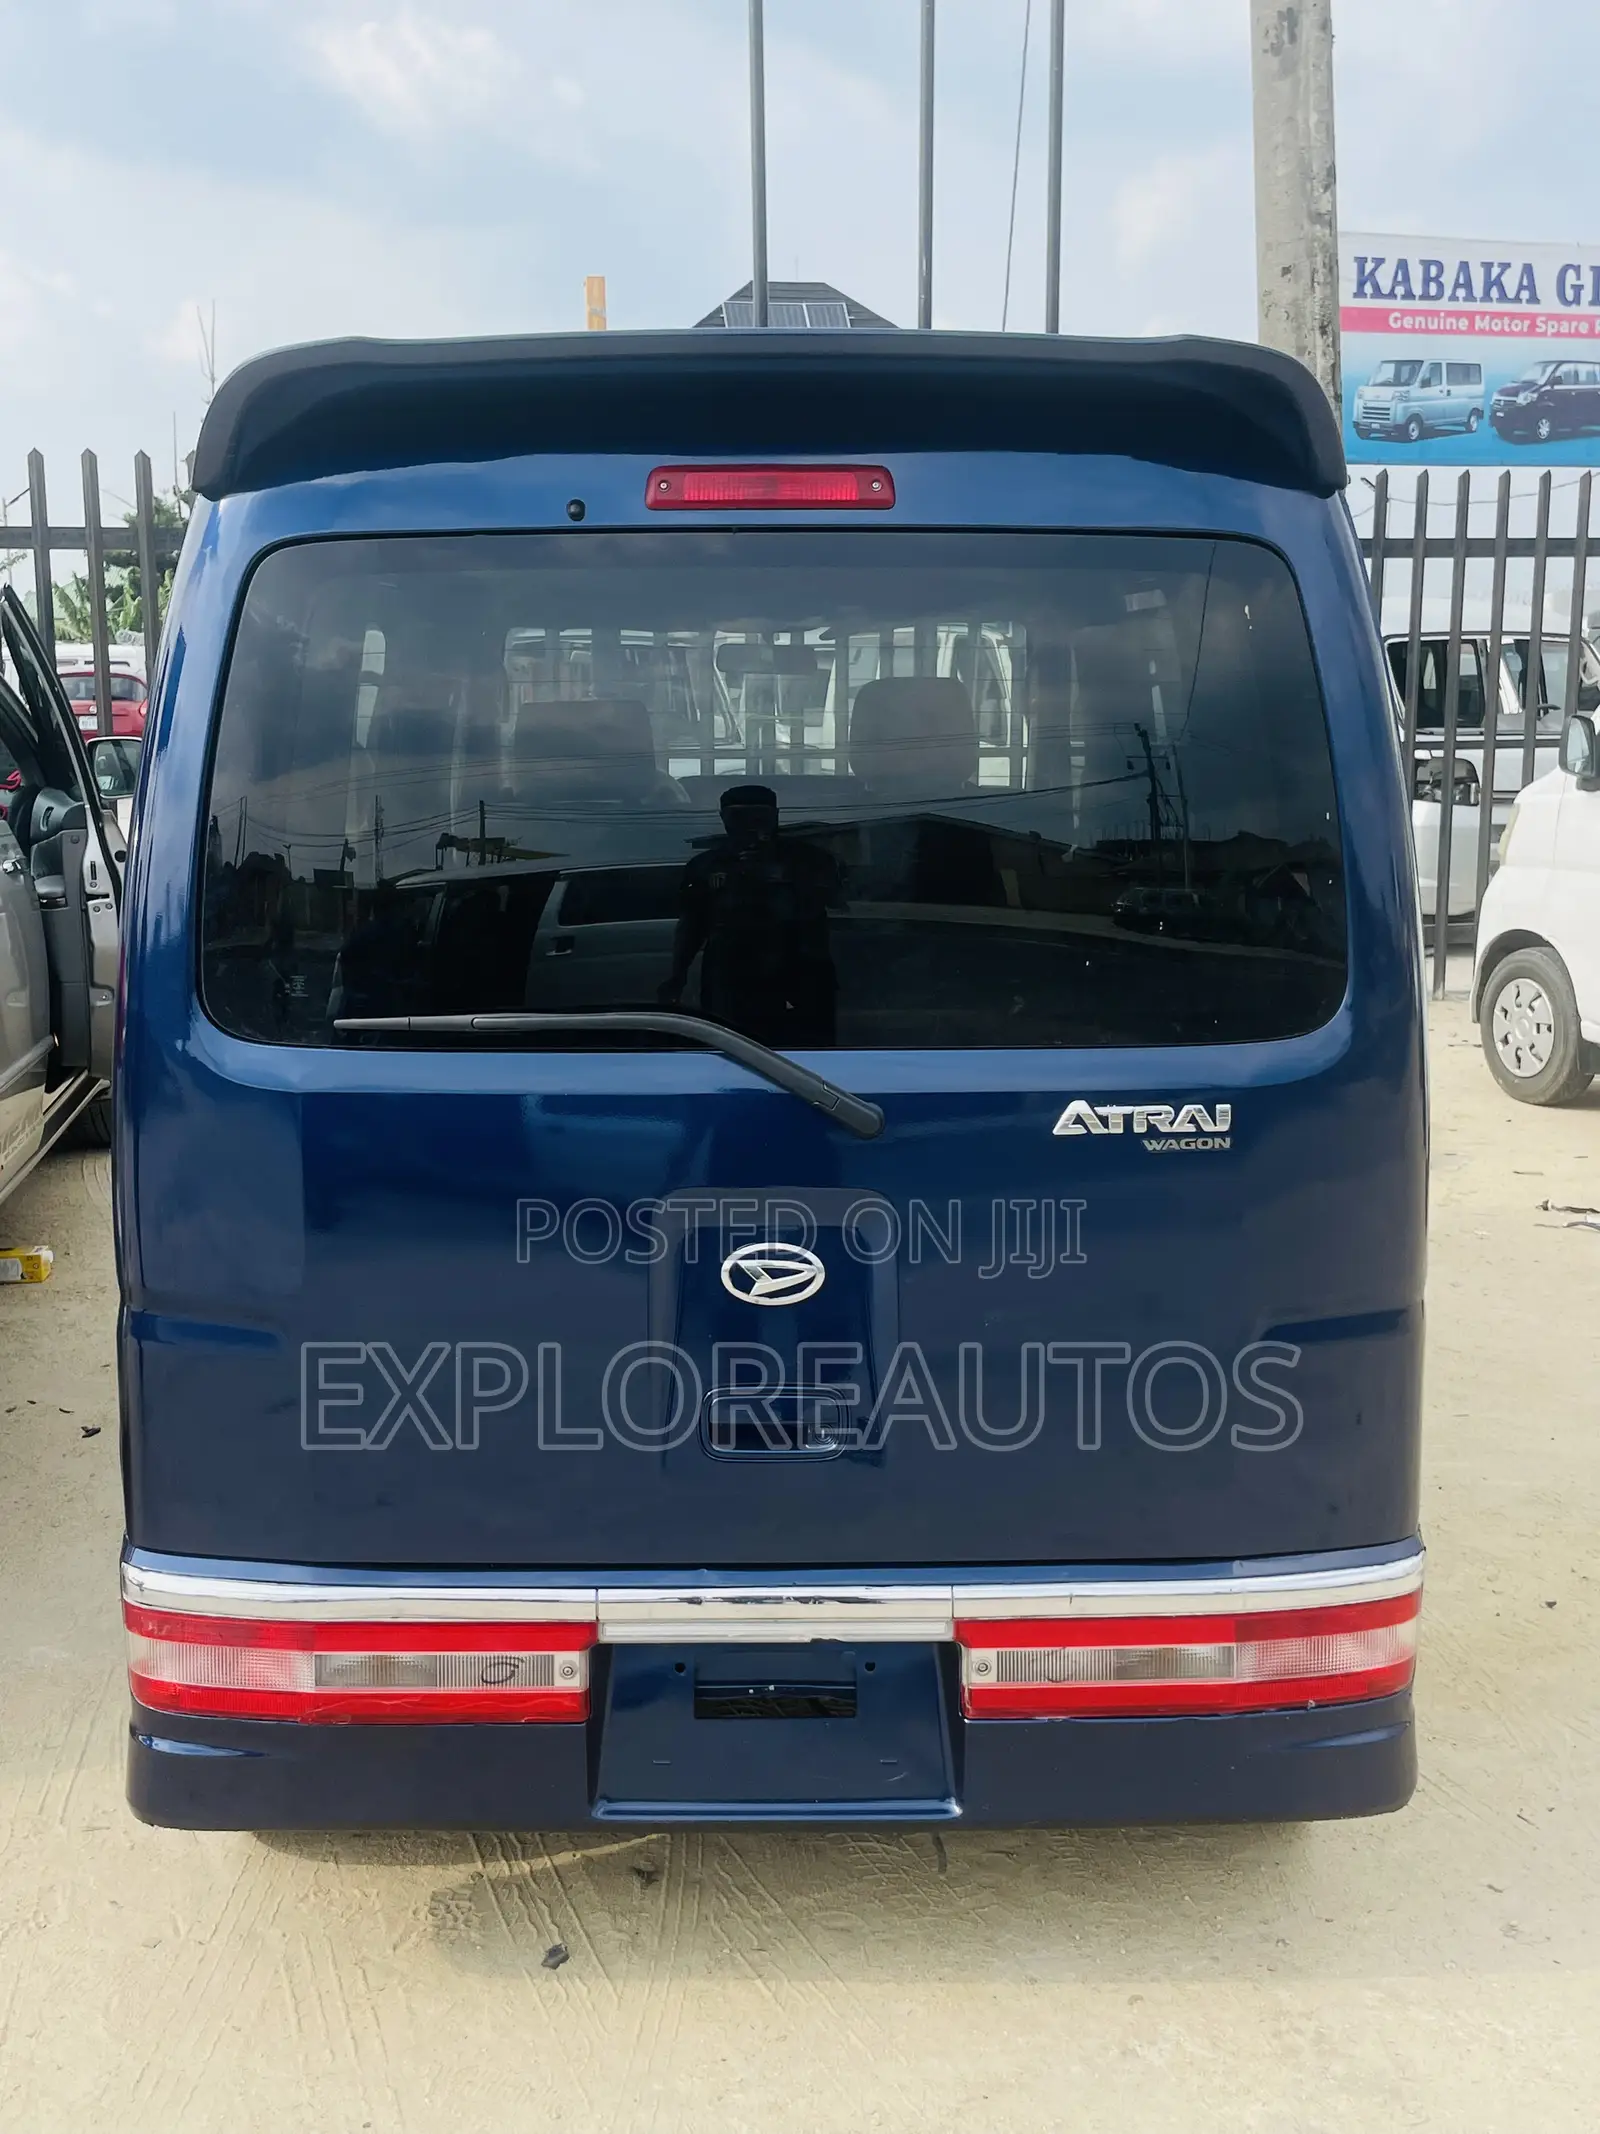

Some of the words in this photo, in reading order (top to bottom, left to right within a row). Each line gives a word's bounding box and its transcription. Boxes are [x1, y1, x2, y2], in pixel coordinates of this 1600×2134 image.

[1353, 256, 1541, 305] KABAKA
[1388, 312, 1469, 330] Genuine
[1475, 315, 1531, 332] Motor
[1535, 316, 1589, 336] Spare
[1052, 1099, 1232, 1135] ATRAI
[1142, 1137, 1231, 1151] WAGON
